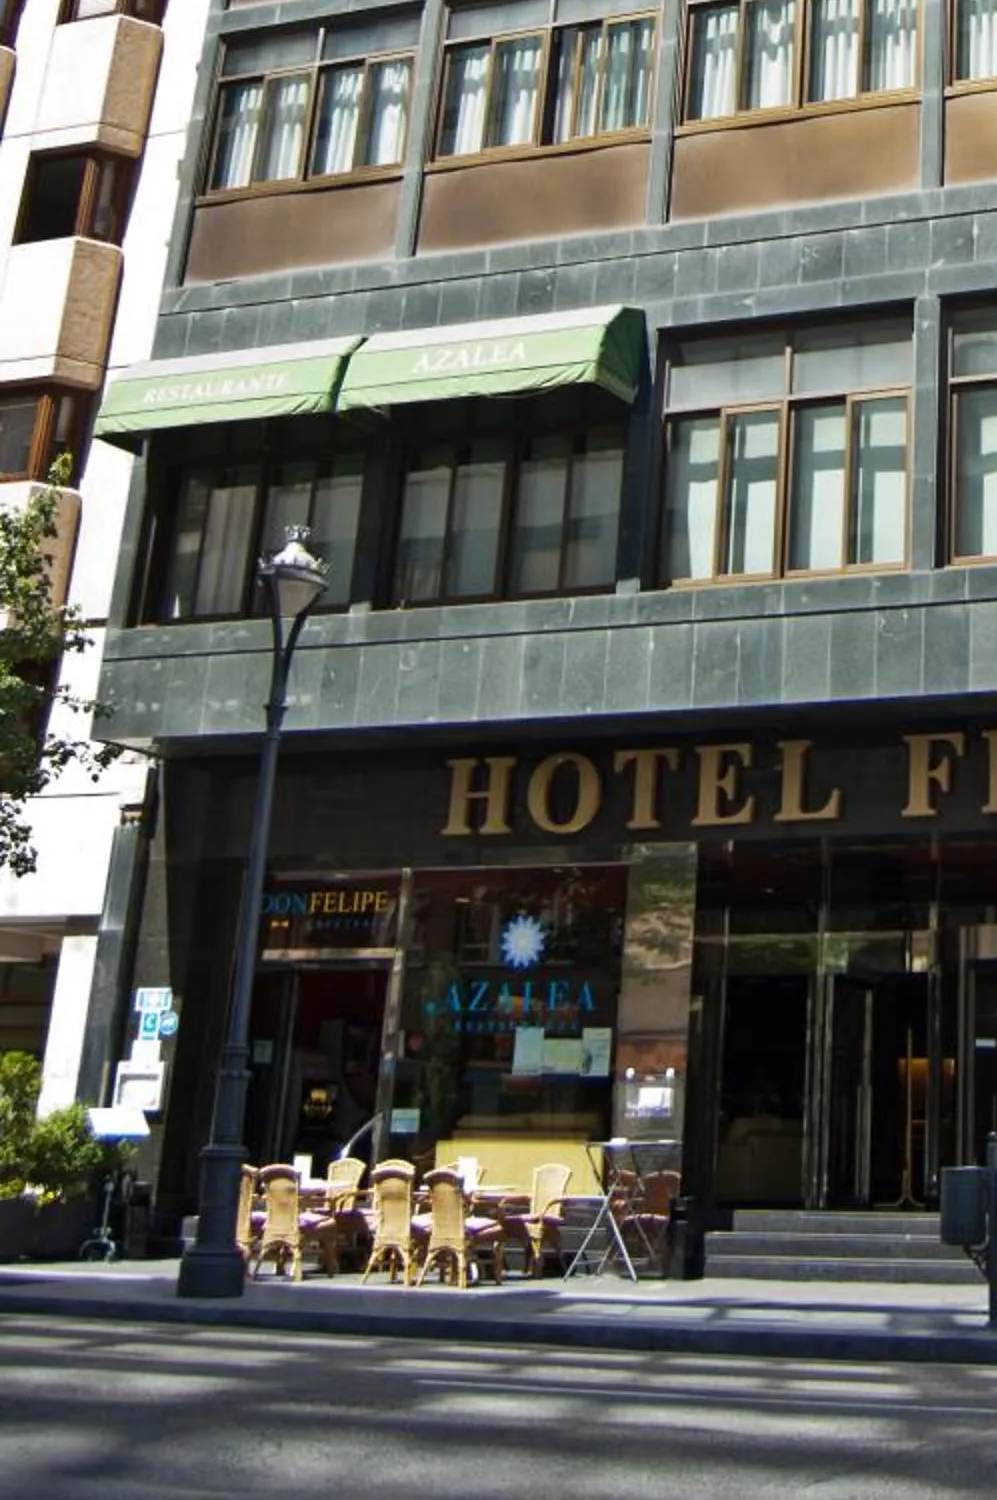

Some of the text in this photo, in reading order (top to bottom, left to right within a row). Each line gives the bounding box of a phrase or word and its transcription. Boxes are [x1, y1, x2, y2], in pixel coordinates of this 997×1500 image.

[411, 341, 525, 374] AZALEA
[440, 739, 843, 836] HOTEL
[446, 980, 596, 1012] AZALEA
